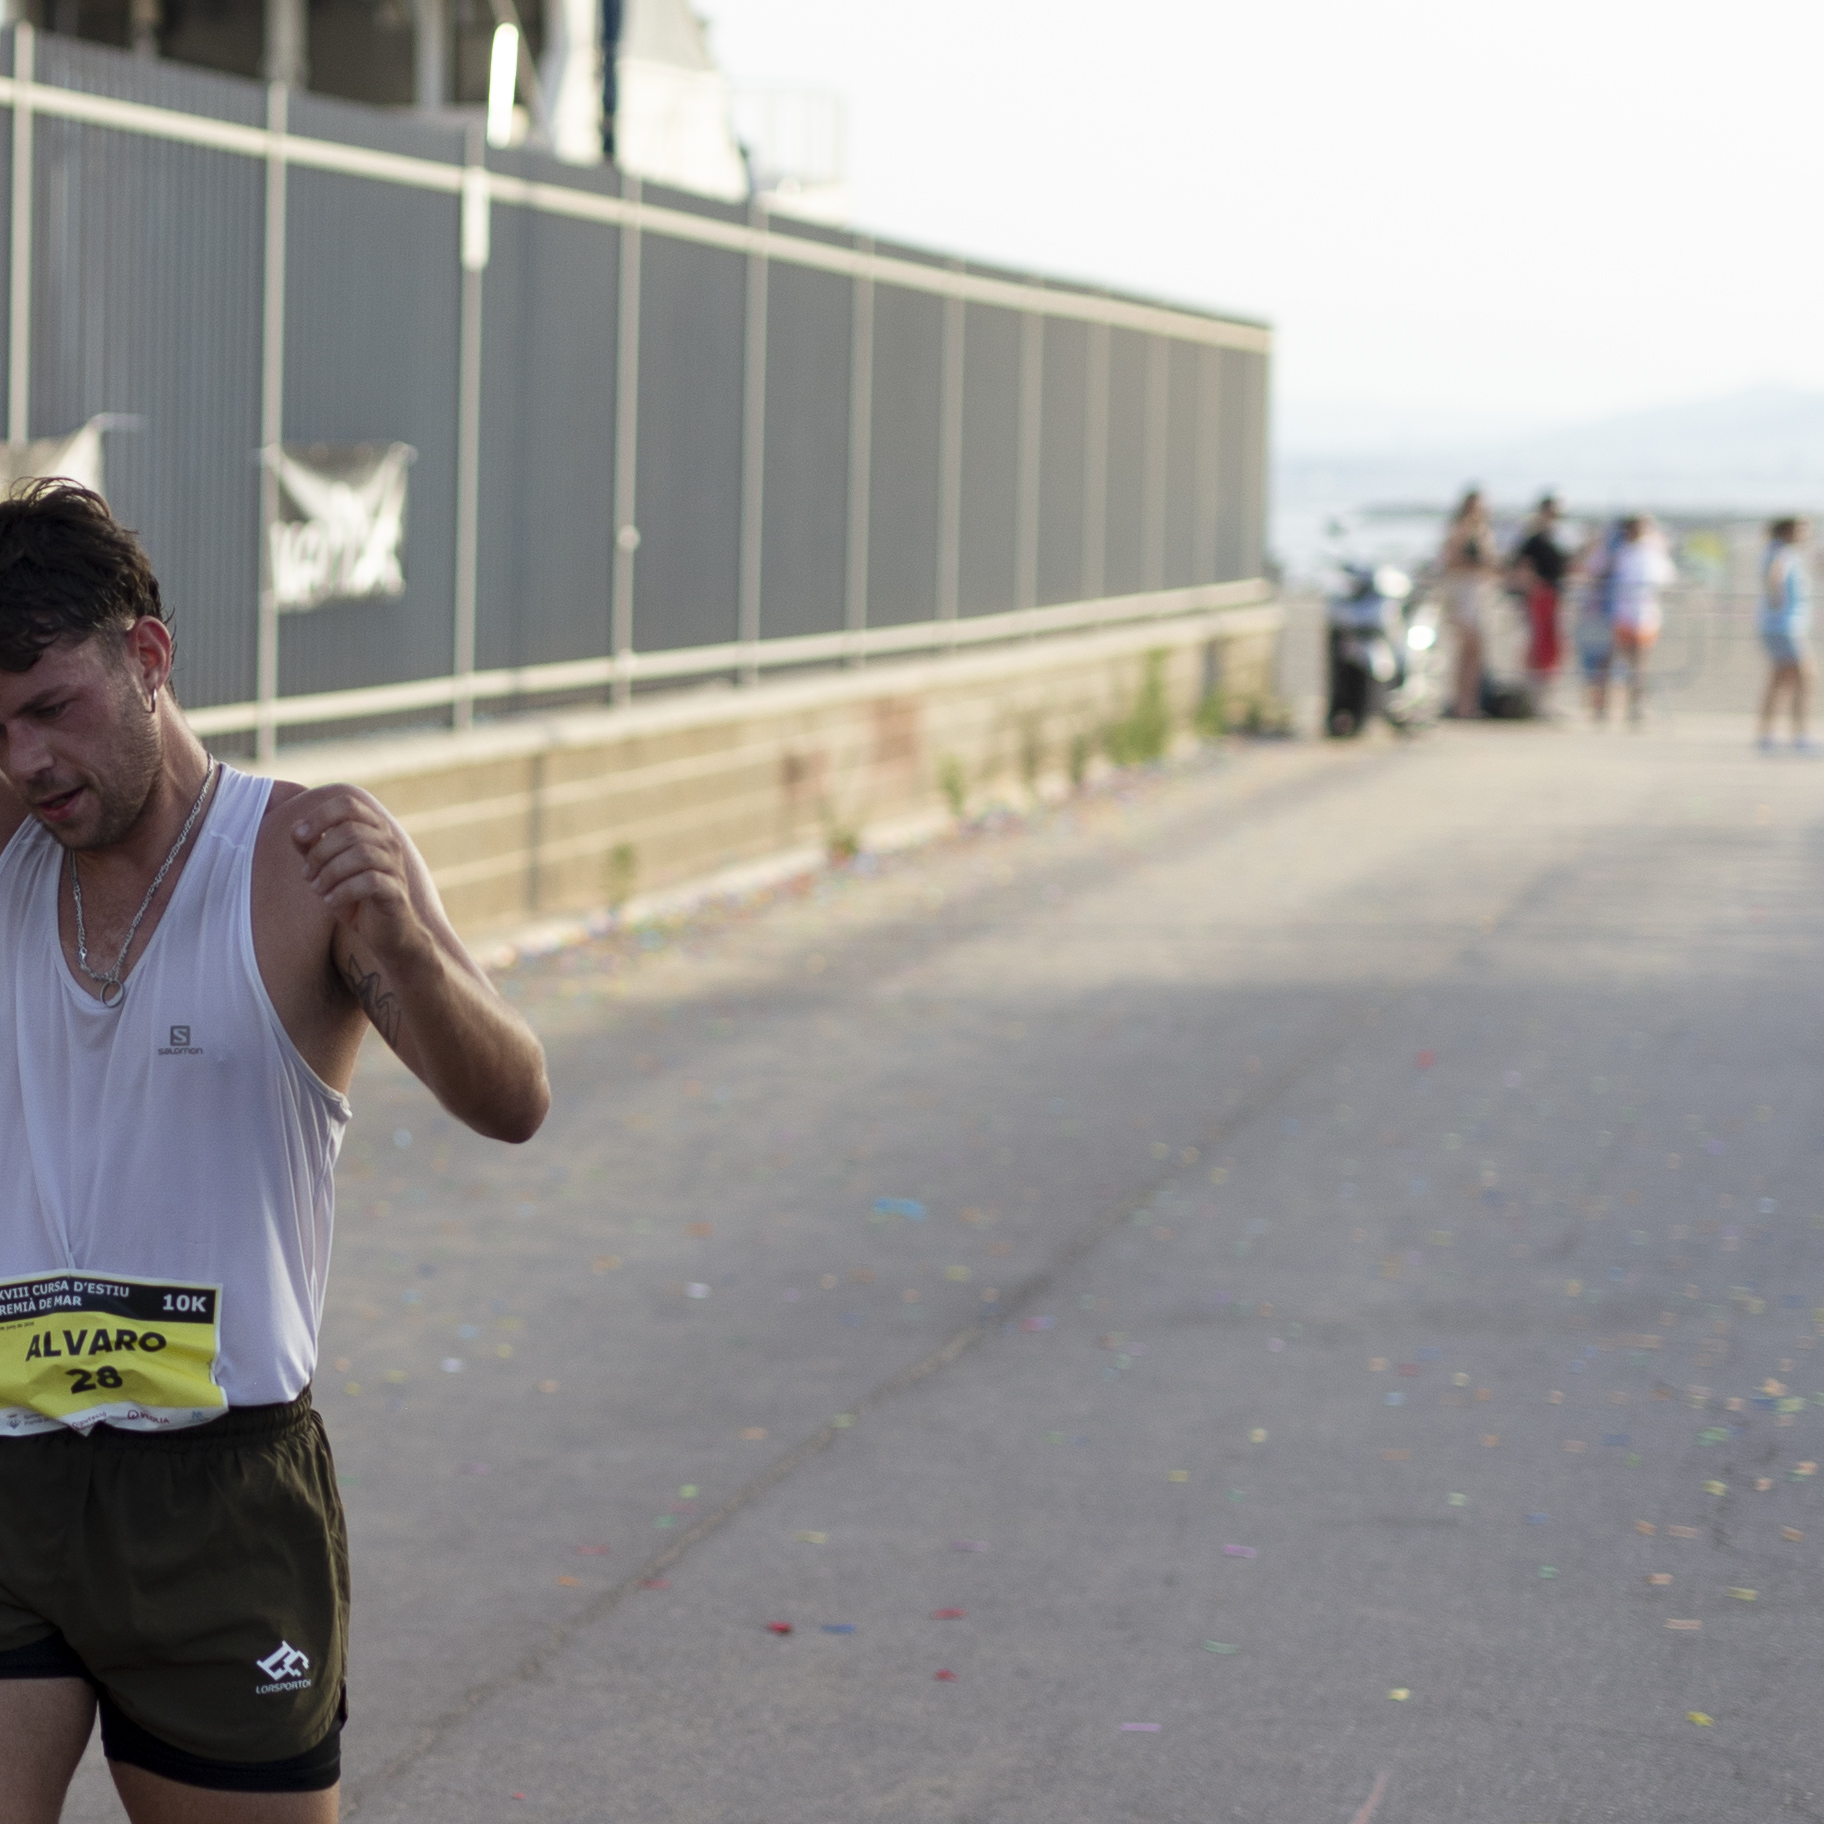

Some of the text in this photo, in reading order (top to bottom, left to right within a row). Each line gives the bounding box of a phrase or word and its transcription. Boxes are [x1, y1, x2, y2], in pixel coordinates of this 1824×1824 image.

[32, 1280, 70, 1297] CURSA
[39, 1297, 53, 1311] DE
[54, 1294, 83, 1307] MAR
[162, 1294, 208, 1313] 10K
[25, 1328, 167, 1361] ALVARO
[65, 1365, 124, 1395] 28
